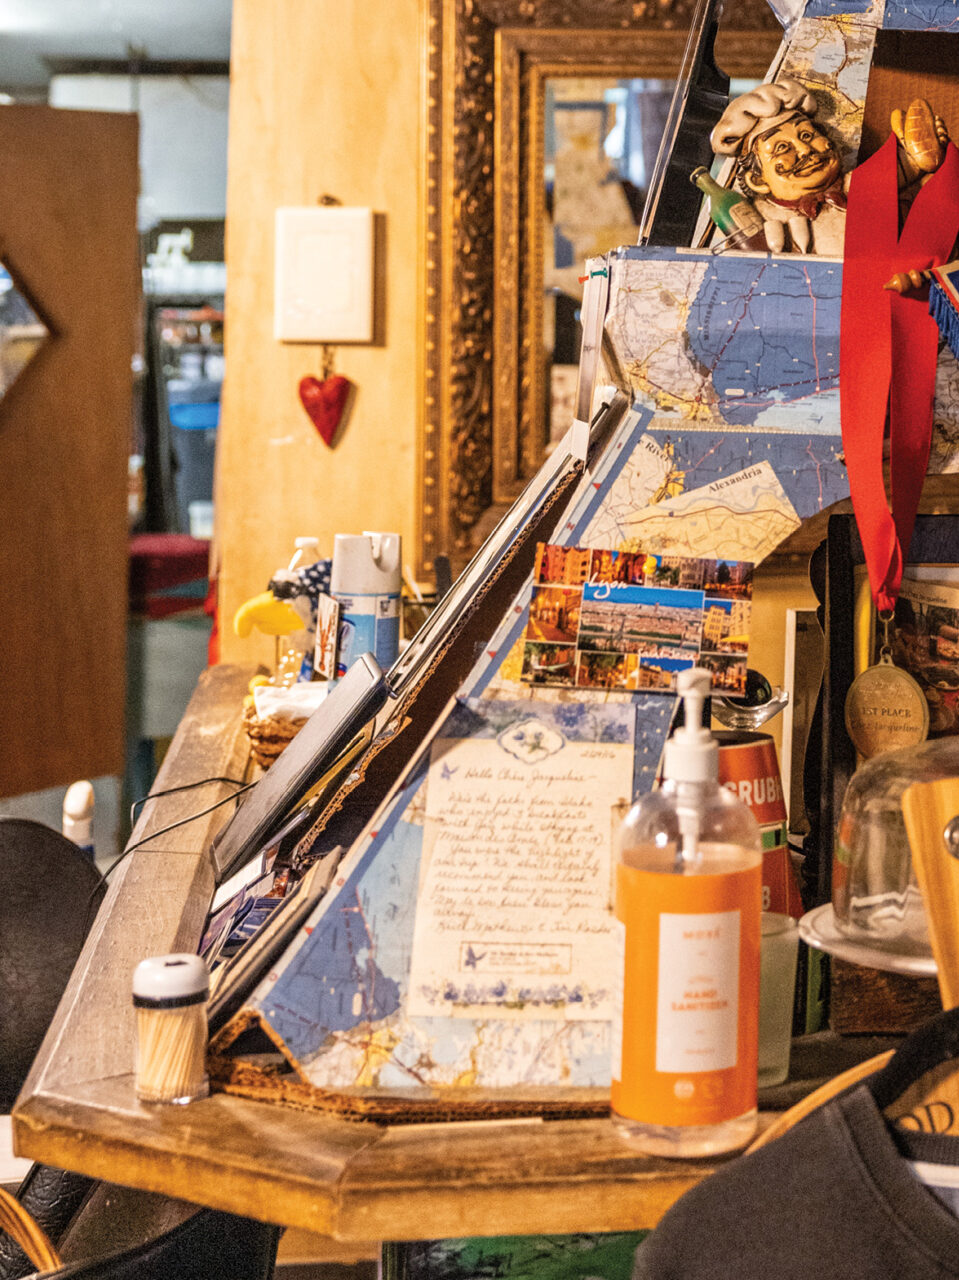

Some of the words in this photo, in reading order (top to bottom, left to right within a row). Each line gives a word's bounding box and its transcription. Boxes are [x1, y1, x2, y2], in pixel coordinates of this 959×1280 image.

[703, 286, 721, 341] MISSISSIPPI
[708, 467, 762, 494] Alexandria
[588, 572, 628, 600] Lyon
[881, 707, 912, 718] PLACE
